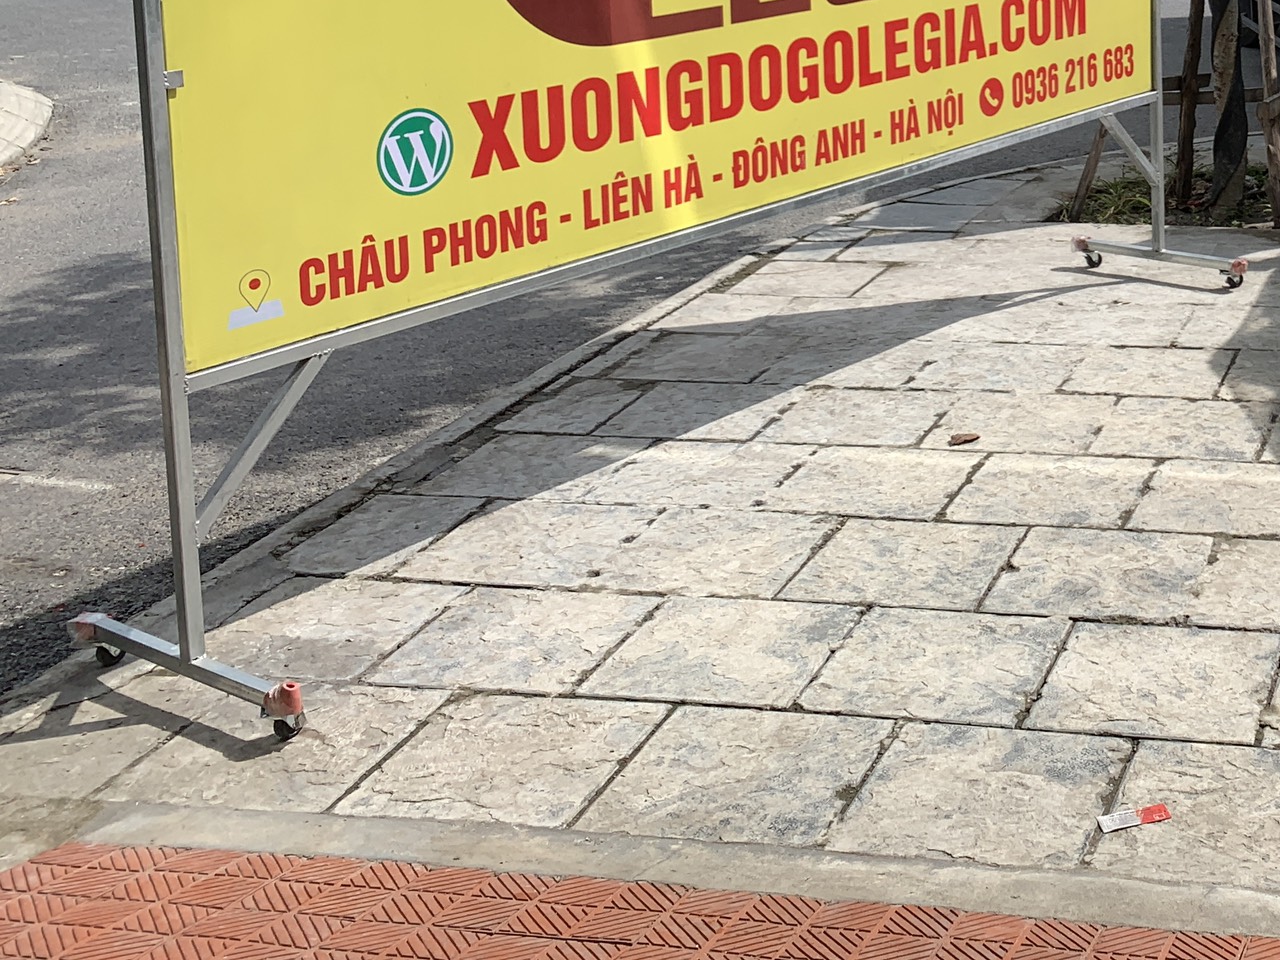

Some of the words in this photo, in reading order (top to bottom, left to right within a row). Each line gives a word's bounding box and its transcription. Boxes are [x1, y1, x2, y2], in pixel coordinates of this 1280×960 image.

[1012, 63, 1058, 108] 0936
[1065, 53, 1098, 95] 216
[1103, 43, 1135, 83] 683
[299, 234, 410, 307] CHÂU
[423, 200, 549, 274] PHONG
[560, 213, 572, 224] -
[582, 171, 654, 231] LIÊN
[663, 154, 704, 210] HÀ
[713, 173, 723, 183] -
[732, 137, 806, 189] ĐÔNG
[815, 119, 866, 167] ANH
[874, 130, 882, 139] -
[890, 98, 921, 145] HÀ
[928, 88, 964, 139] NỘI
